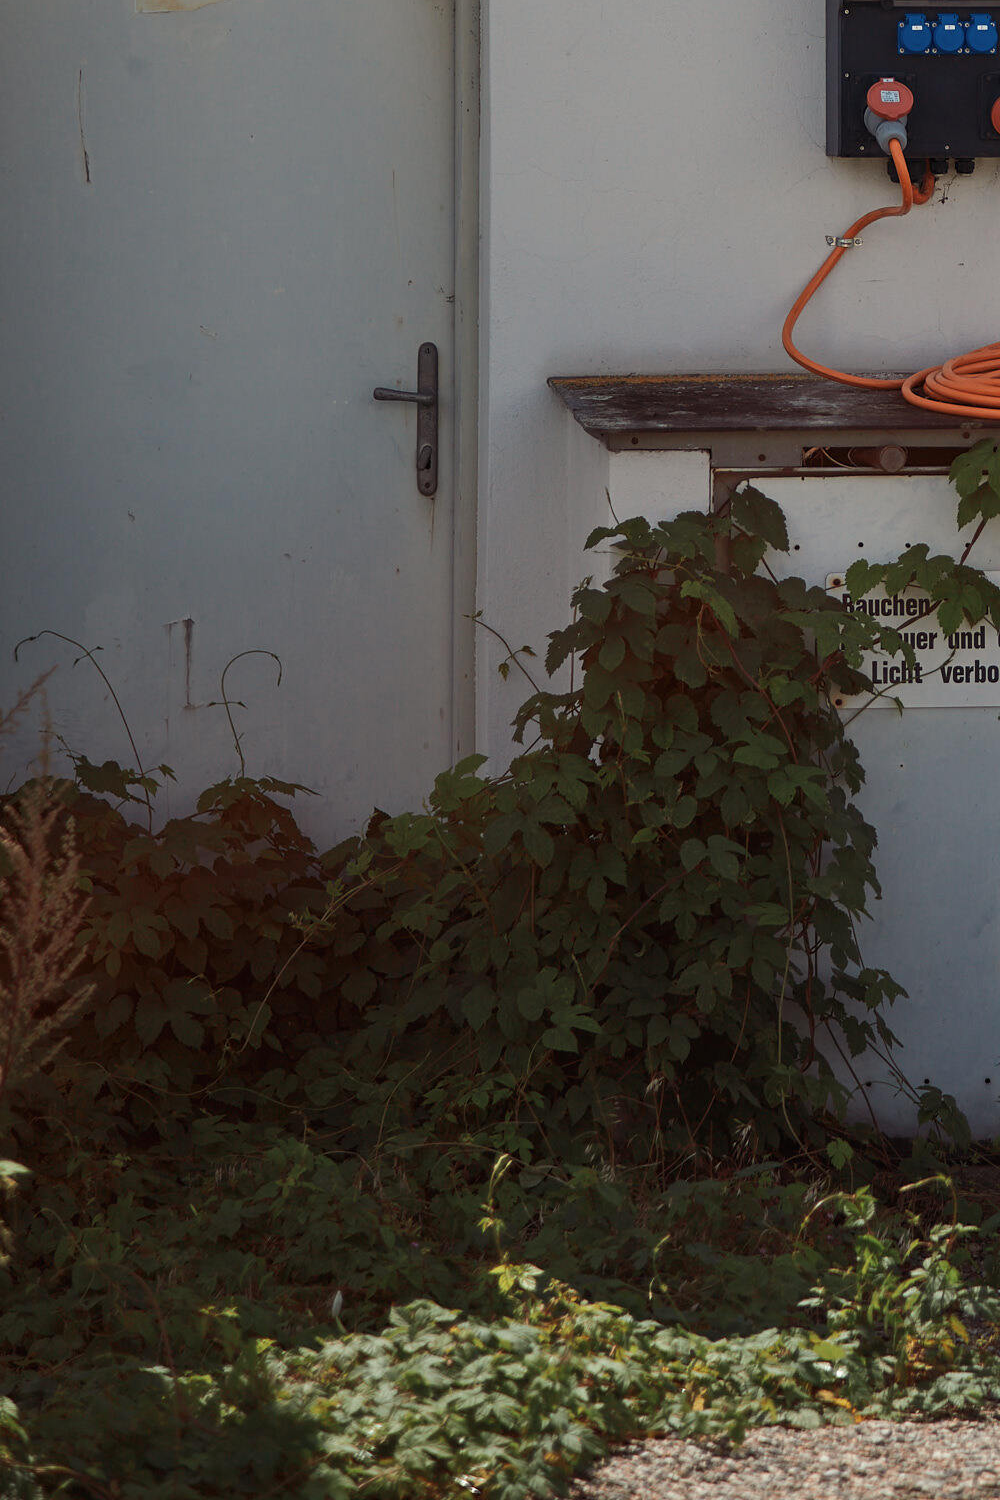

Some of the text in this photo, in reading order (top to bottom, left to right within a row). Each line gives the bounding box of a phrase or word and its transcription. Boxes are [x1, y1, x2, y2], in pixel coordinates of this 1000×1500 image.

[881, 630, 938, 650] uer
[948, 626, 986, 650] und
[872, 660, 923, 684] Licht
